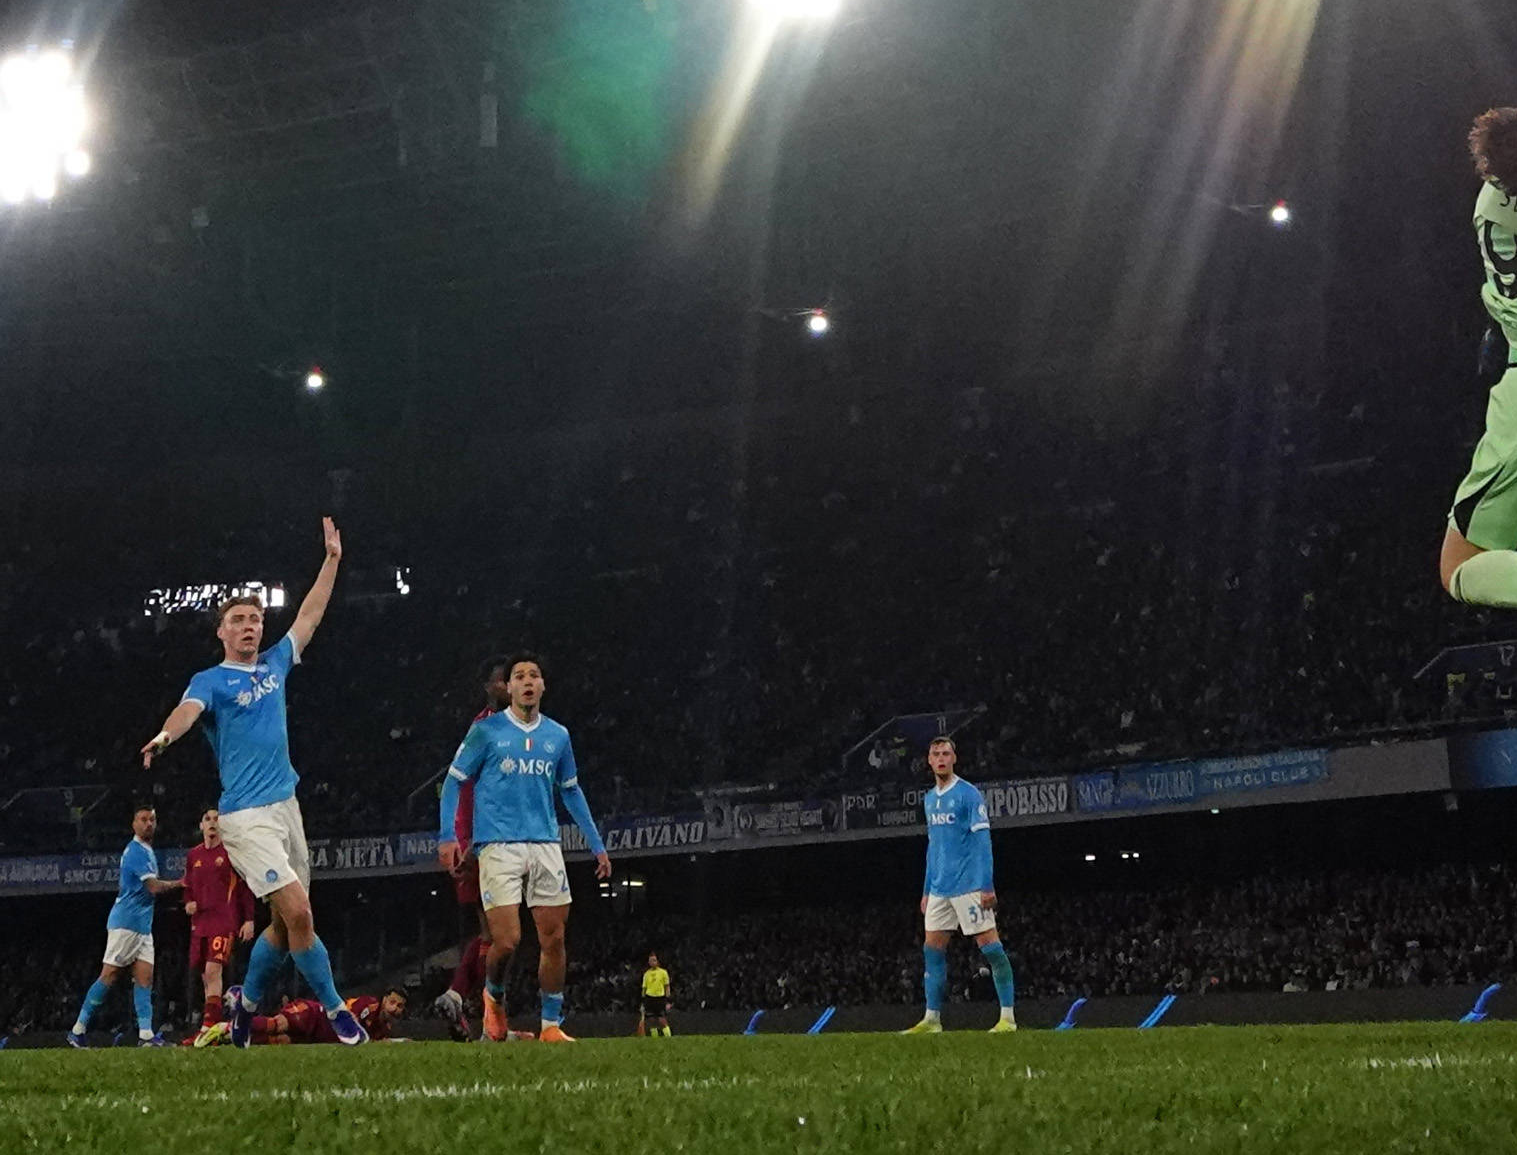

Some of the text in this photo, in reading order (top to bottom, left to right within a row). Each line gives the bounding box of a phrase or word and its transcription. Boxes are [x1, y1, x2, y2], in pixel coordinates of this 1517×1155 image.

[252, 674, 280, 702] MSC
[518, 758, 554, 775] MSC
[931, 812, 956, 825] MSC
[605, 821, 705, 851] CAIVANO
[335, 843, 394, 869] META
[212, 936, 229, 953] 61
